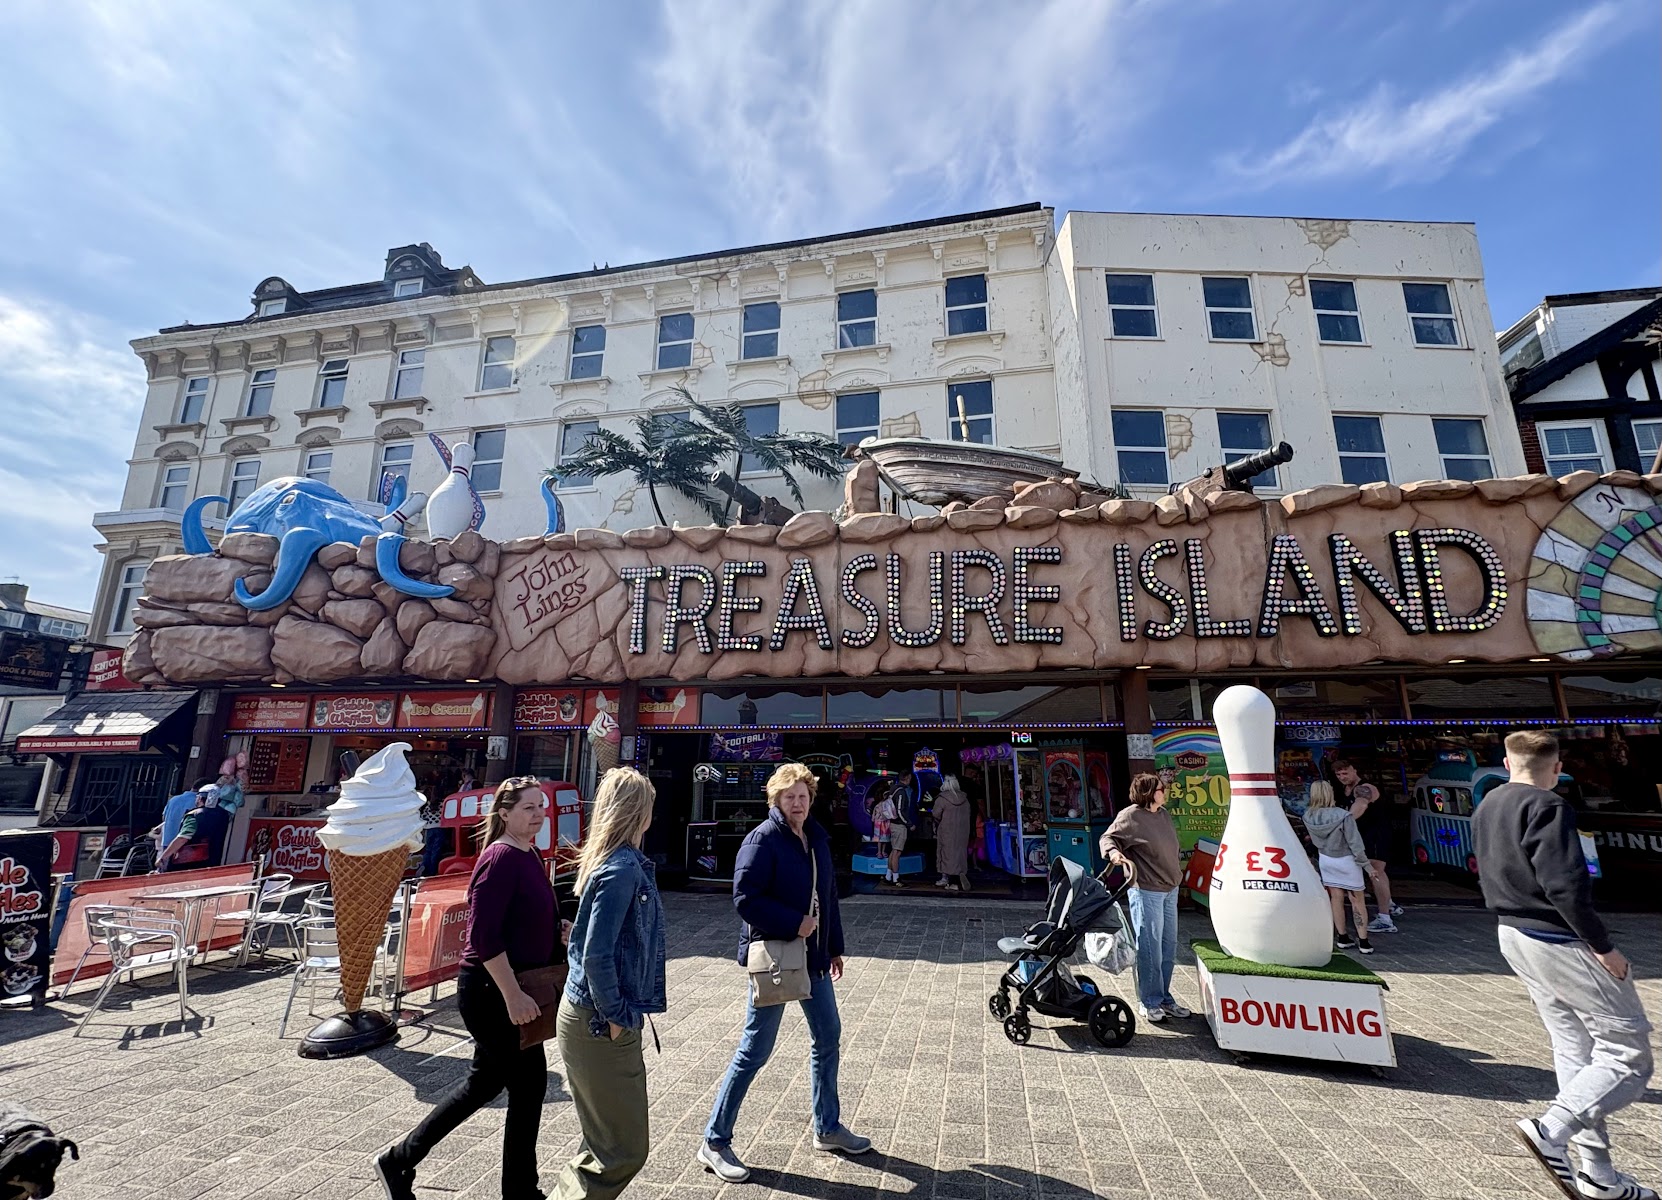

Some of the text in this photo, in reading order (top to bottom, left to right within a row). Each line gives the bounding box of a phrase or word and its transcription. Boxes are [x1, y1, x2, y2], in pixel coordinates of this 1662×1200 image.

[507, 551, 582, 600] John
[620, 528, 1507, 654] TREASURE ISLAND
[513, 568, 590, 629] Lings
[94, 657, 121, 672] ENJOY
[95, 669, 119, 683] HERE
[258, 700, 277, 708] Cold
[277, 700, 304, 709] Drinks
[333, 697, 374, 711] Bubble
[515, 693, 557, 708] Bubble
[639, 701, 674, 712] ream
[411, 702, 472, 715] Ice Cream
[329, 711, 373, 726] Waffles
[726, 732, 767, 746] FOOTBALL
[1178, 757, 1205, 765] CASINO
[1170, 808, 1187, 816] ALL
[1190, 808, 1214, 816] CASH
[278, 825, 321, 848] Bubble
[273, 847, 321, 872] Waffles
[1246, 846, 1291, 878] £3
[1245, 881, 1296, 892] PER GAME
[2, 912, 48, 924] Made Here
[443, 951, 457, 961] HOT
[1220, 997, 1382, 1037] BOWLING
